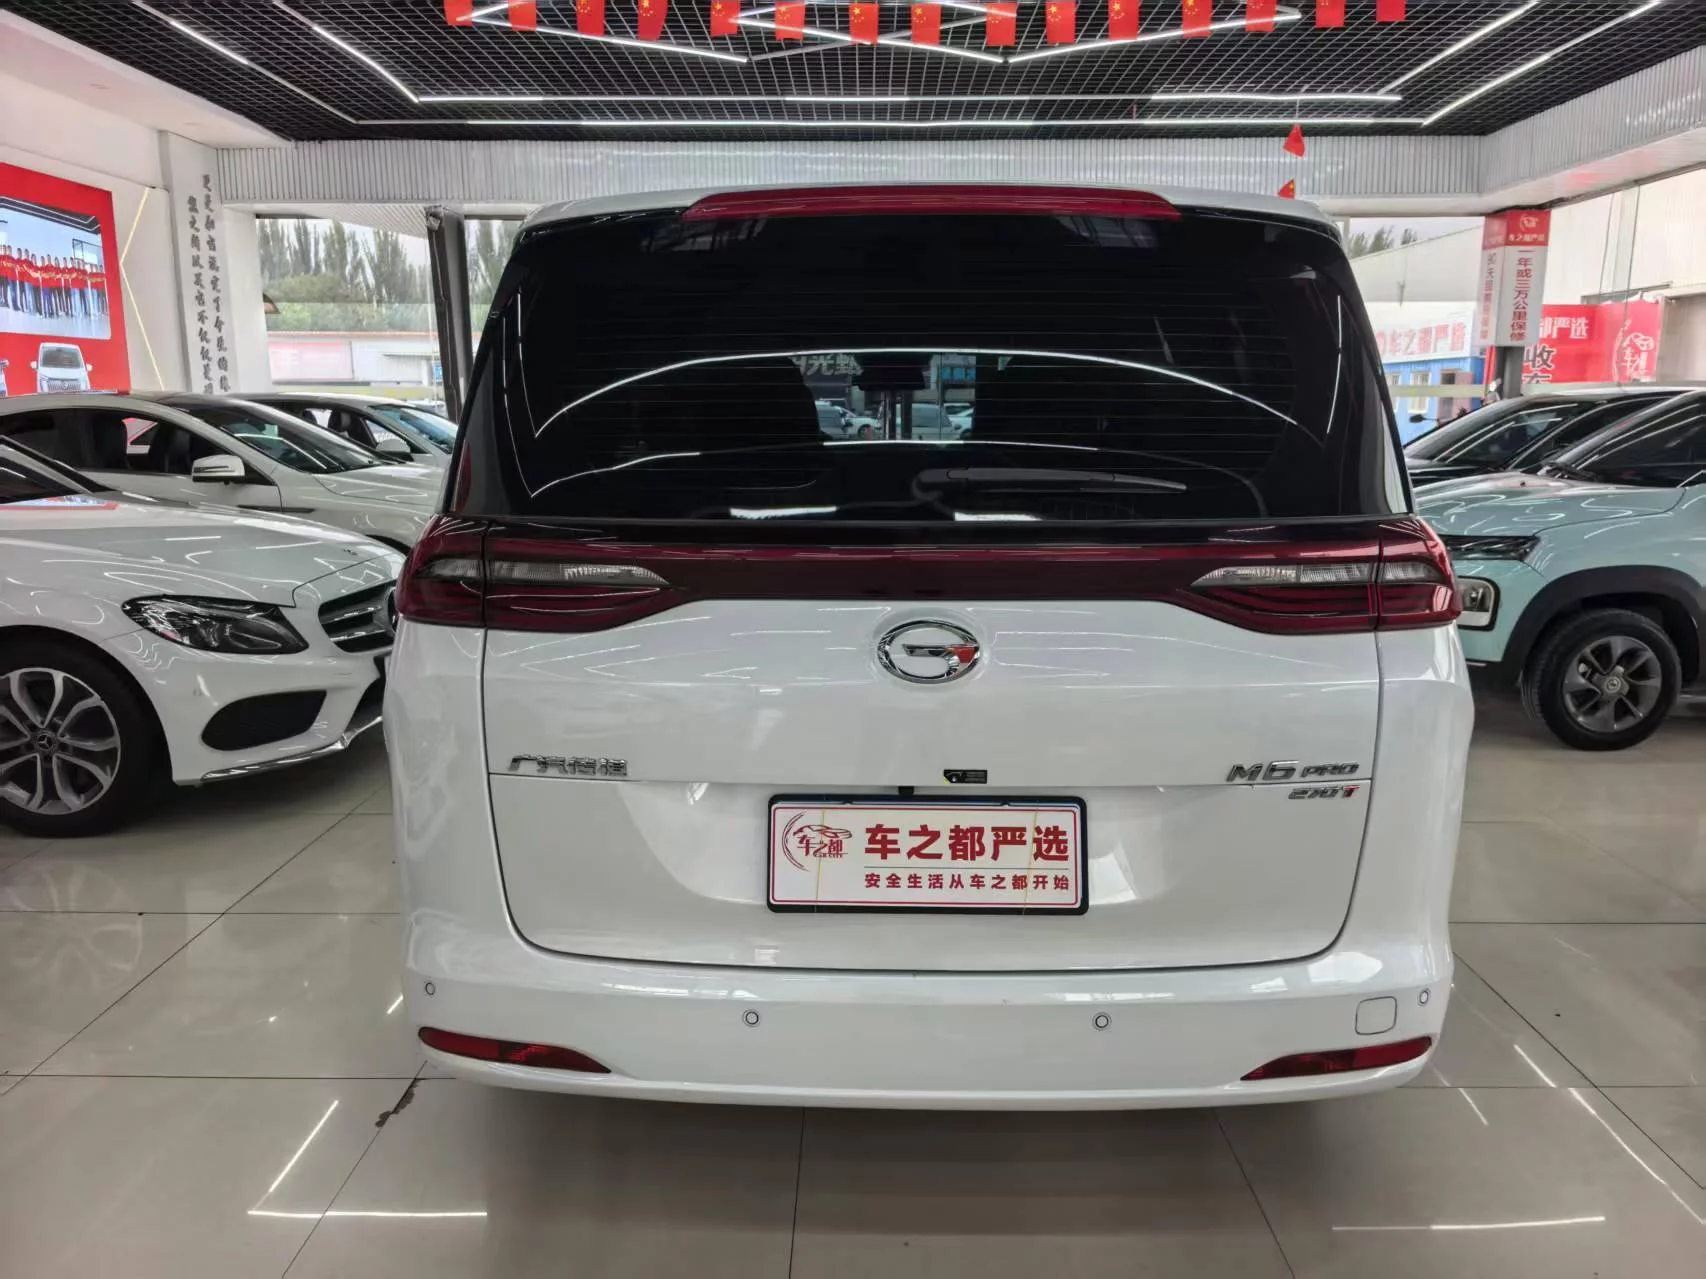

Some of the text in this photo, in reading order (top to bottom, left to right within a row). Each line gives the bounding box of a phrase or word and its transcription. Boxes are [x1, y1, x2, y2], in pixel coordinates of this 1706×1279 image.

[1509, 249, 1537, 342] 一年或三万公里保修
[507, 753, 628, 776] 广汽传祺
[1226, 760, 1360, 782] M6 PRO
[1288, 785, 1361, 800] 270T
[864, 824, 1069, 862] 车之都严选
[864, 872, 1069, 891] 安全生活从车之都开始
